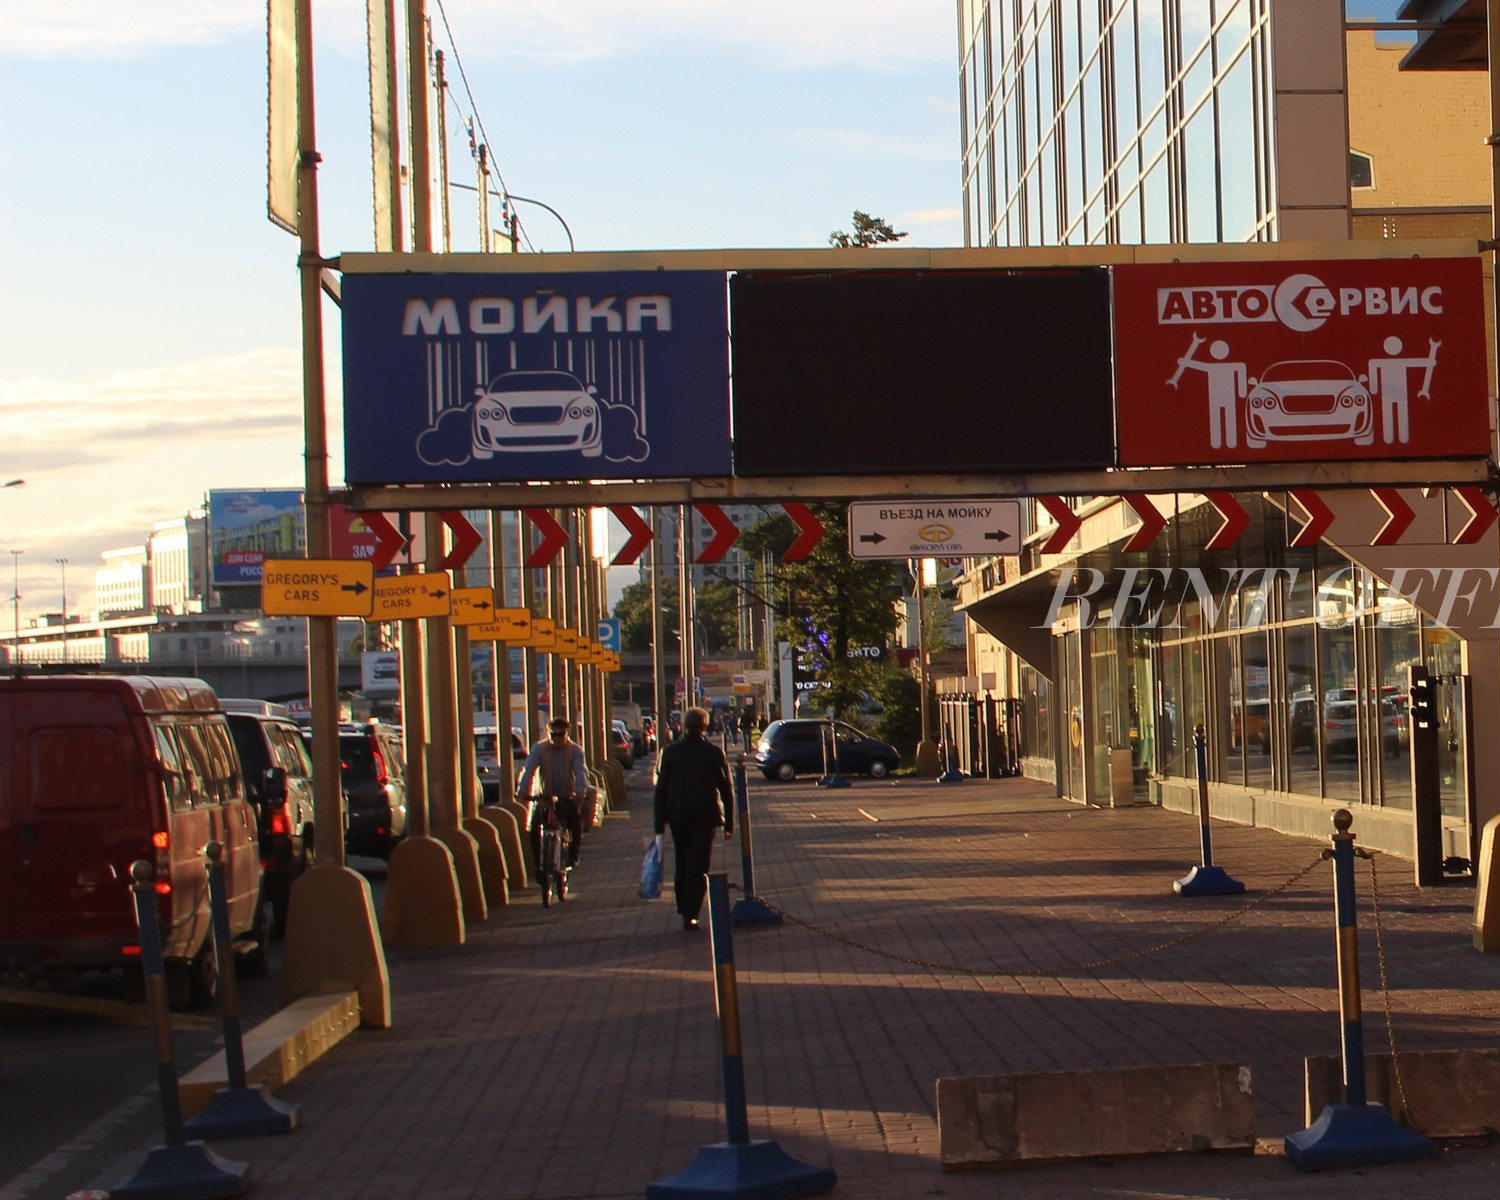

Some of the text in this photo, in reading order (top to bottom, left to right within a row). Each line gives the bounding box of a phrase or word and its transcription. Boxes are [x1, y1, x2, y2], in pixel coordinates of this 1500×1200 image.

[401, 286, 672, 335] МОЙКА
[879, 507, 992, 520] ВЪЕЗД НА МОЙКУ
[266, 573, 339, 586] GREGORY'S
[284, 590, 320, 601] CARS
[374, 584, 428, 598] REGORY'S
[382, 598, 412, 609] CARS
